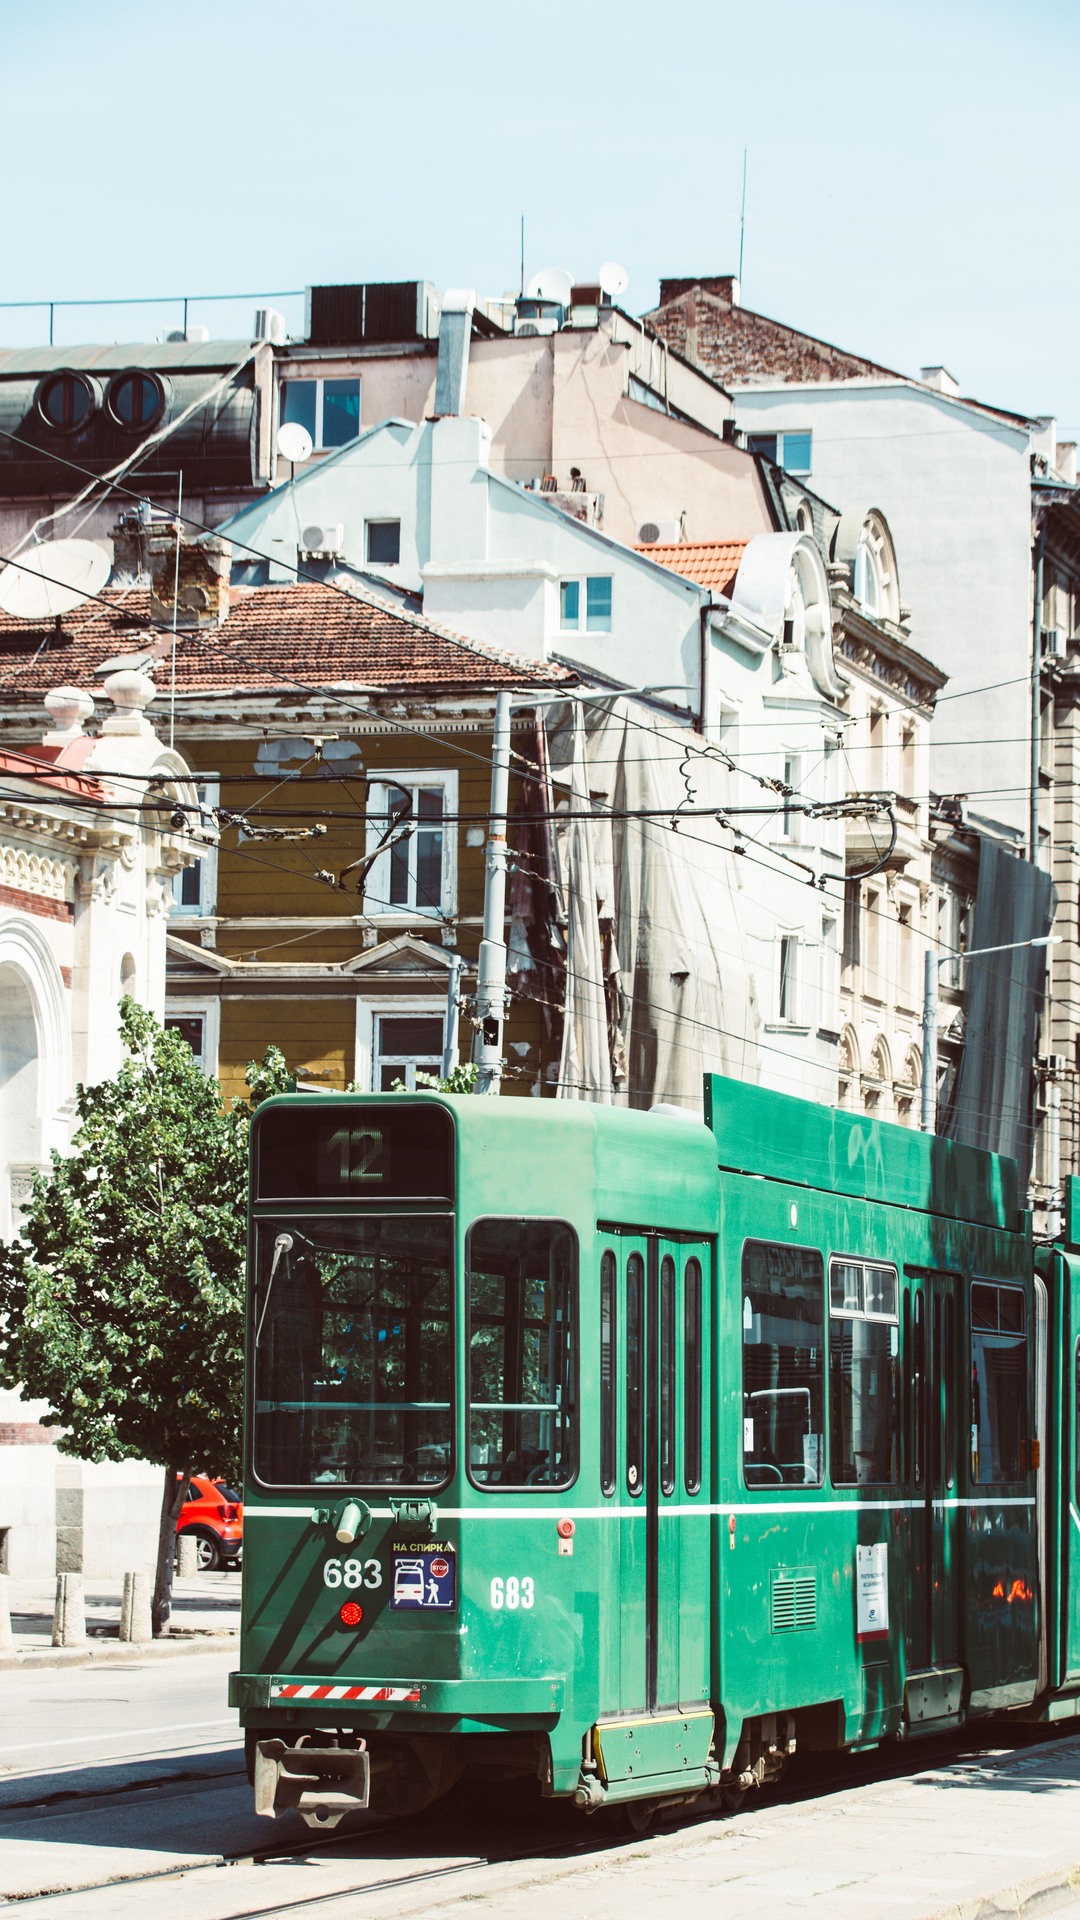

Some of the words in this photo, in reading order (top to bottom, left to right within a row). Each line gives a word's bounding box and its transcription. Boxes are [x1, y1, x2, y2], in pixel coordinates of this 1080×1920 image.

[327, 1129, 383, 1183] 12
[393, 1543, 408, 1552] НА
[410, 1543, 454, 1552] СПИРКА
[323, 1558, 382, 1589] 683
[490, 1576, 535, 1609] 683
